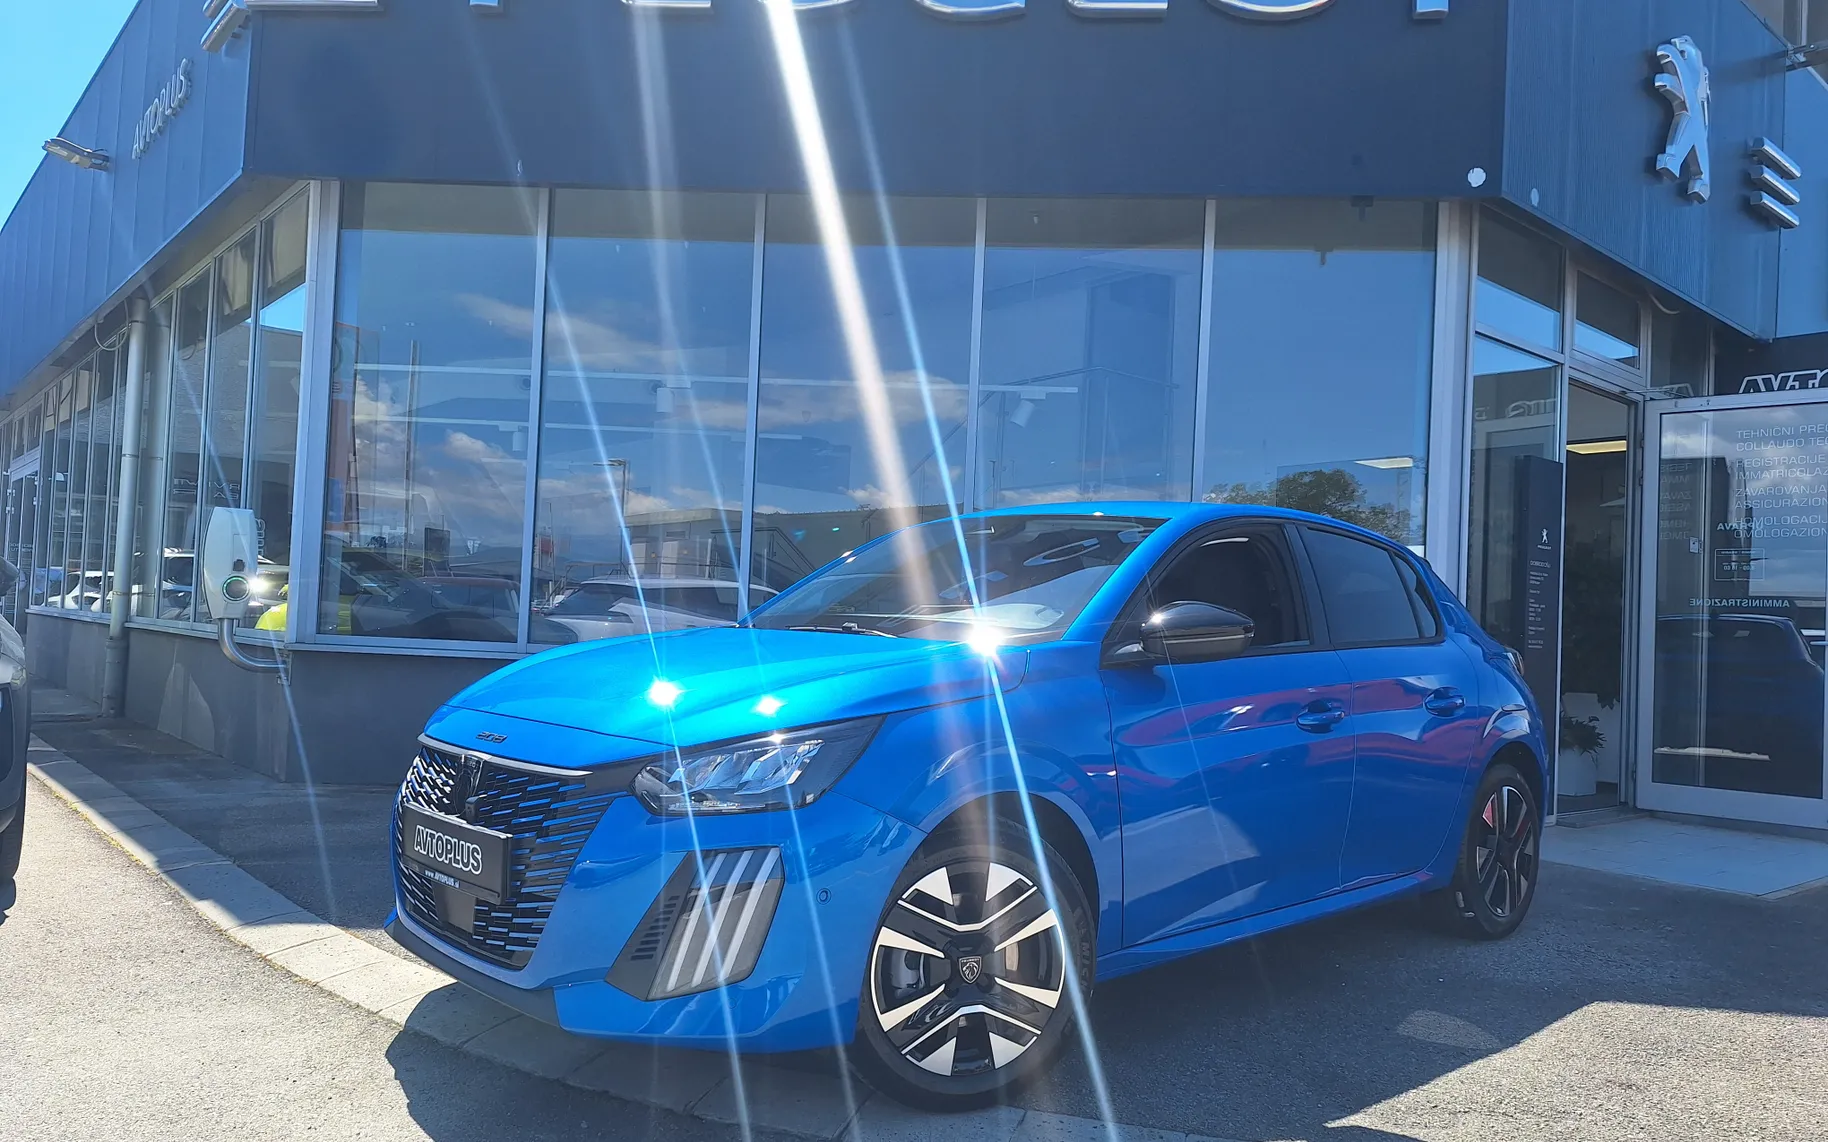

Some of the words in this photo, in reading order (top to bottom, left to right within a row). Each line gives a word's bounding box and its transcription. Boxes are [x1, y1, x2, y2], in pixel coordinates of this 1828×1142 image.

[131, 58, 191, 160] AVTOPLUS
[1736, 425, 1795, 439] TEHNIČNI
[1736, 438, 1804, 452] COLLAUDO
[1736, 454, 1825, 468] REGISTRACIJE
[1735, 484, 1827, 497] ZAVAROVANJA
[475, 731, 508, 744] 208
[414, 824, 482, 875] AVTOPLUS
